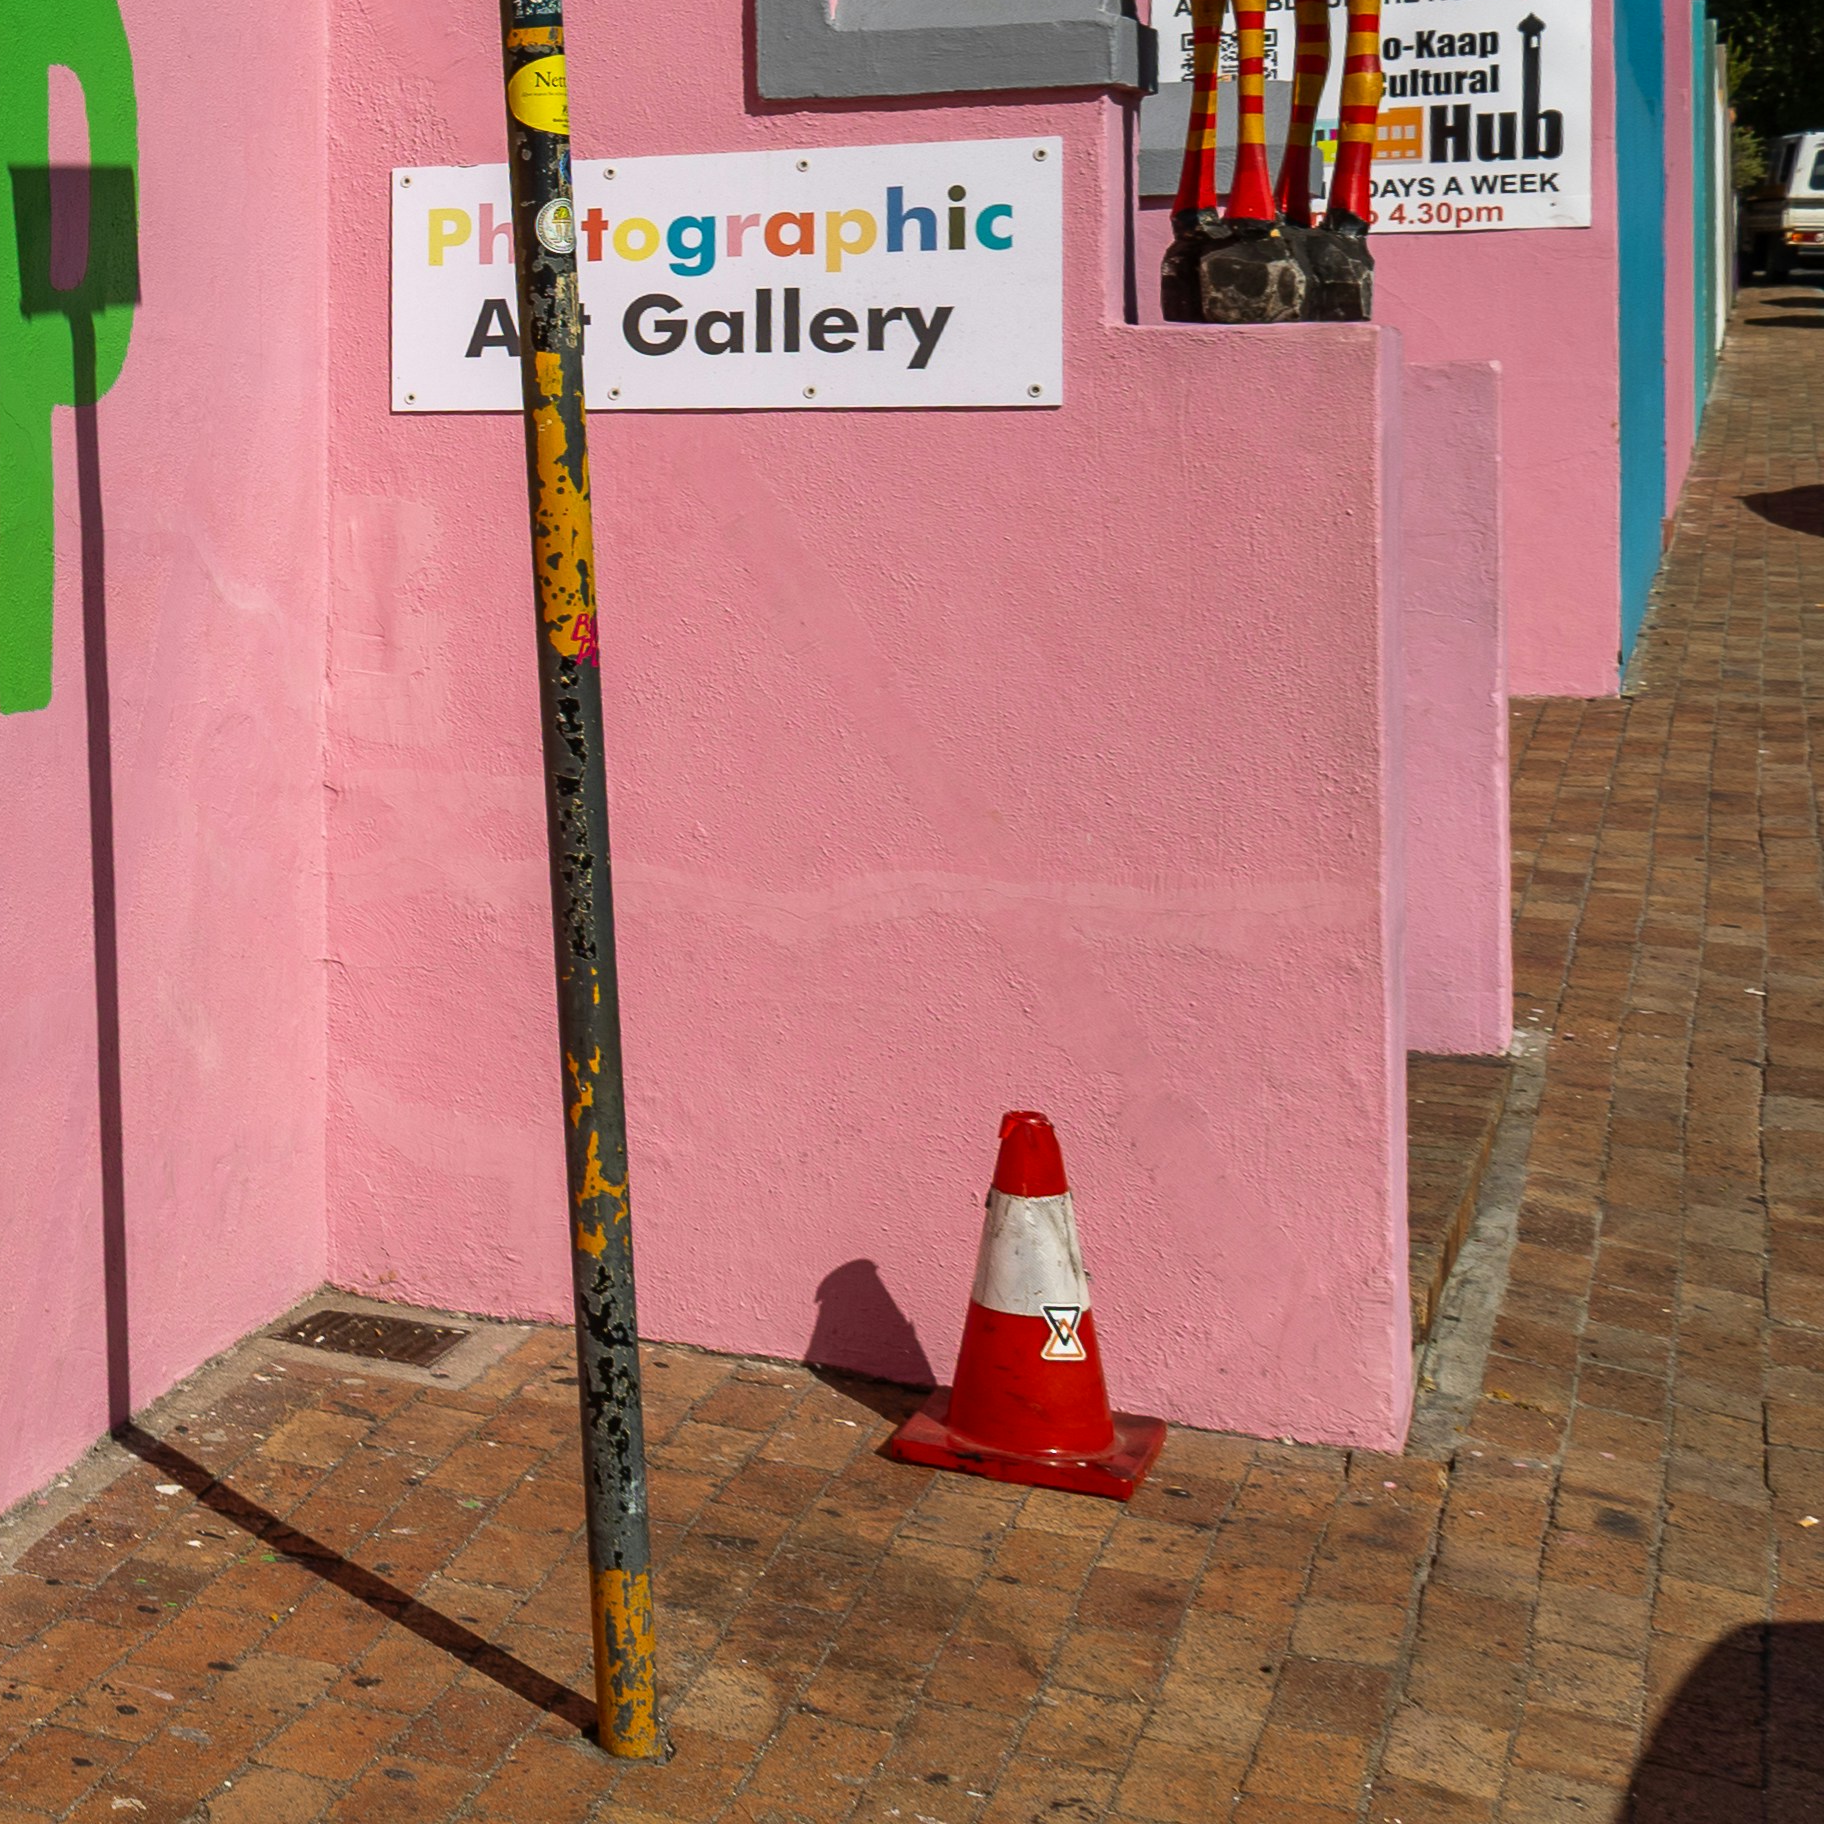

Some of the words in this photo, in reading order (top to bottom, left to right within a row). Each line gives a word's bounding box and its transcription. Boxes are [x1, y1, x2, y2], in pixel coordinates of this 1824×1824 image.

[1382, 30, 1499, 61] o-Kaap
[1443, 176, 1463, 196] A
[1471, 172, 1560, 195] WEEK
[1388, 201, 1503, 227] 4.30pm
[427, 185, 1014, 277] Phtographic
[622, 287, 955, 370] Gallery
